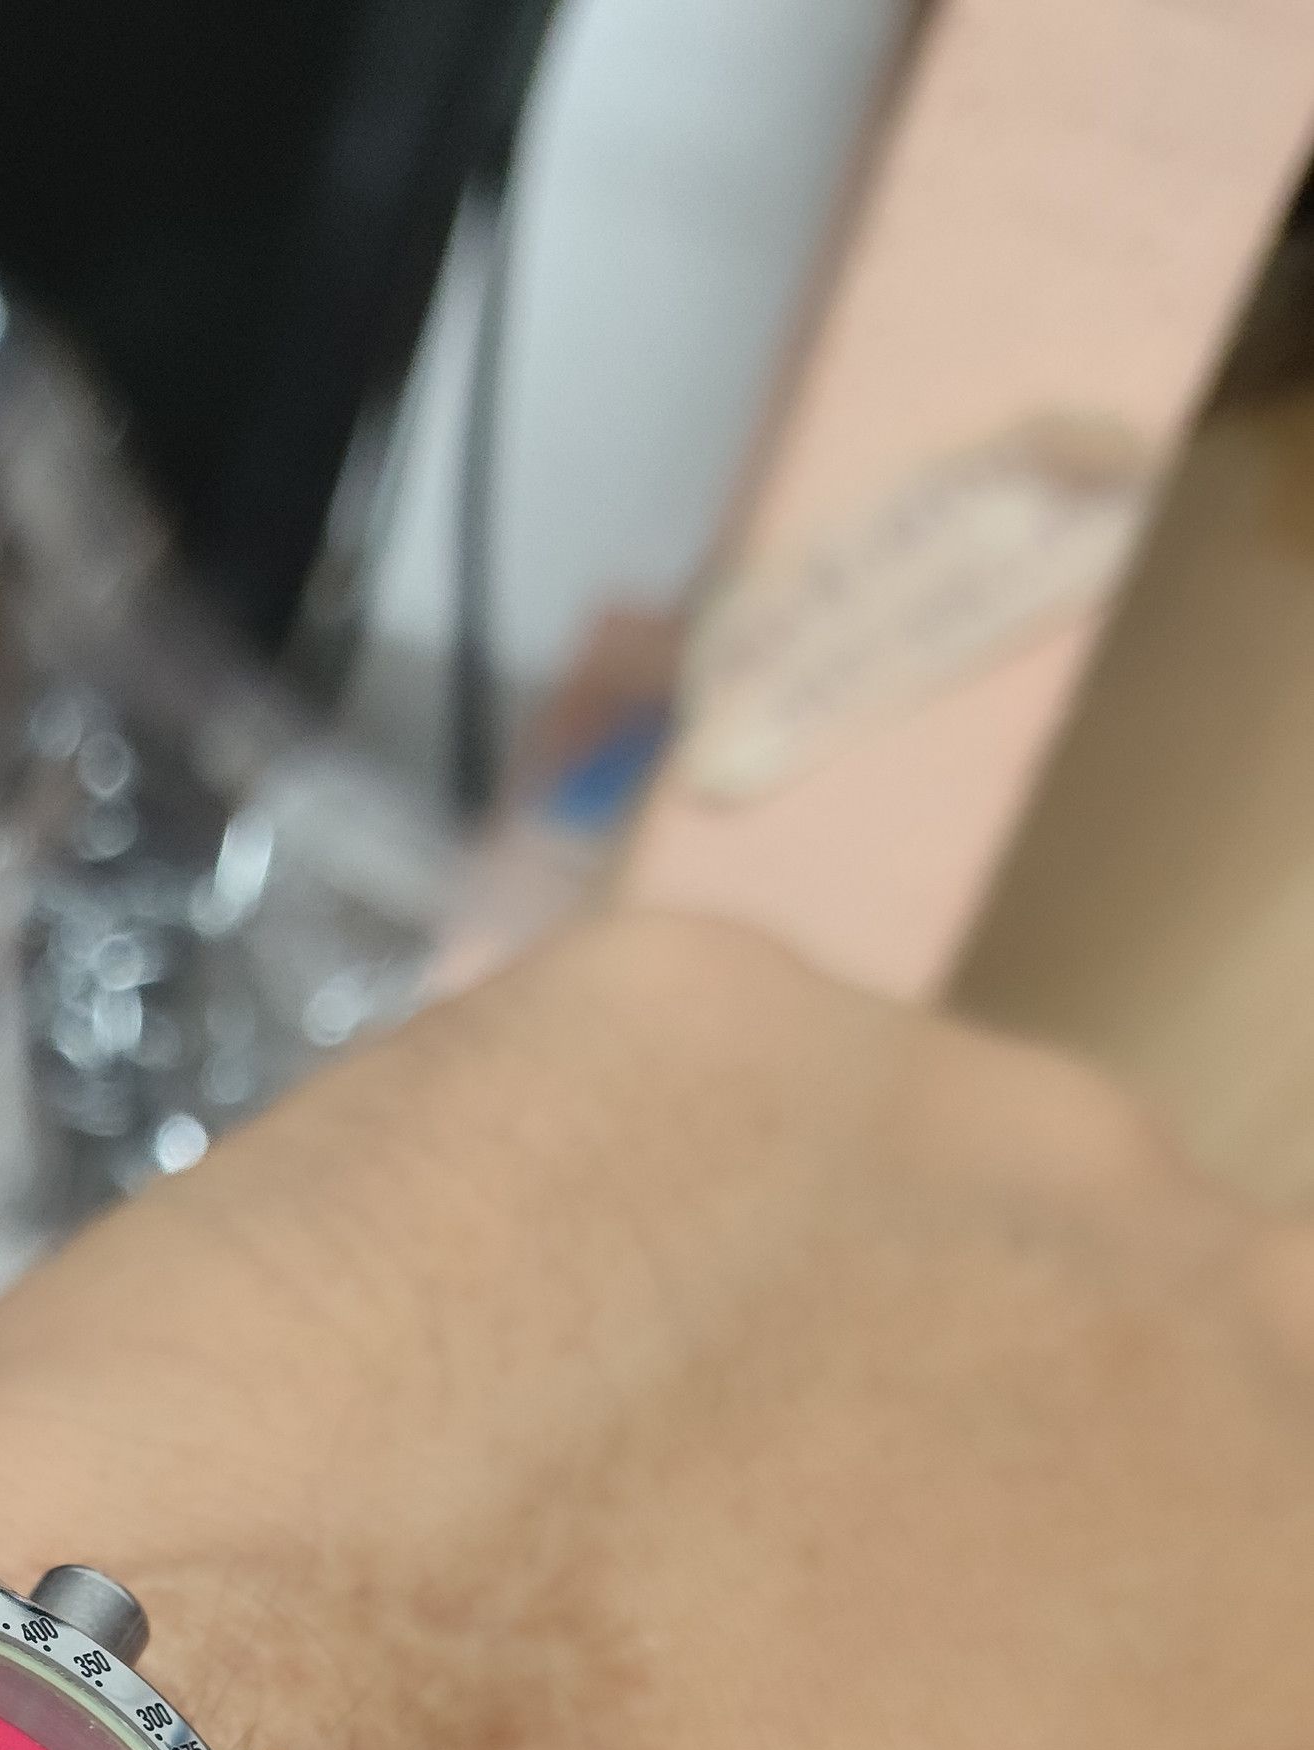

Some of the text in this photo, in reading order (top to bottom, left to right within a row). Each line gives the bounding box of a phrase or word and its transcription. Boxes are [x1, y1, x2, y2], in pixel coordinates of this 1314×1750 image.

[20, 1616, 59, 1644] 400
[73, 1649, 112, 1680] 350
[135, 1701, 174, 1733] 300
